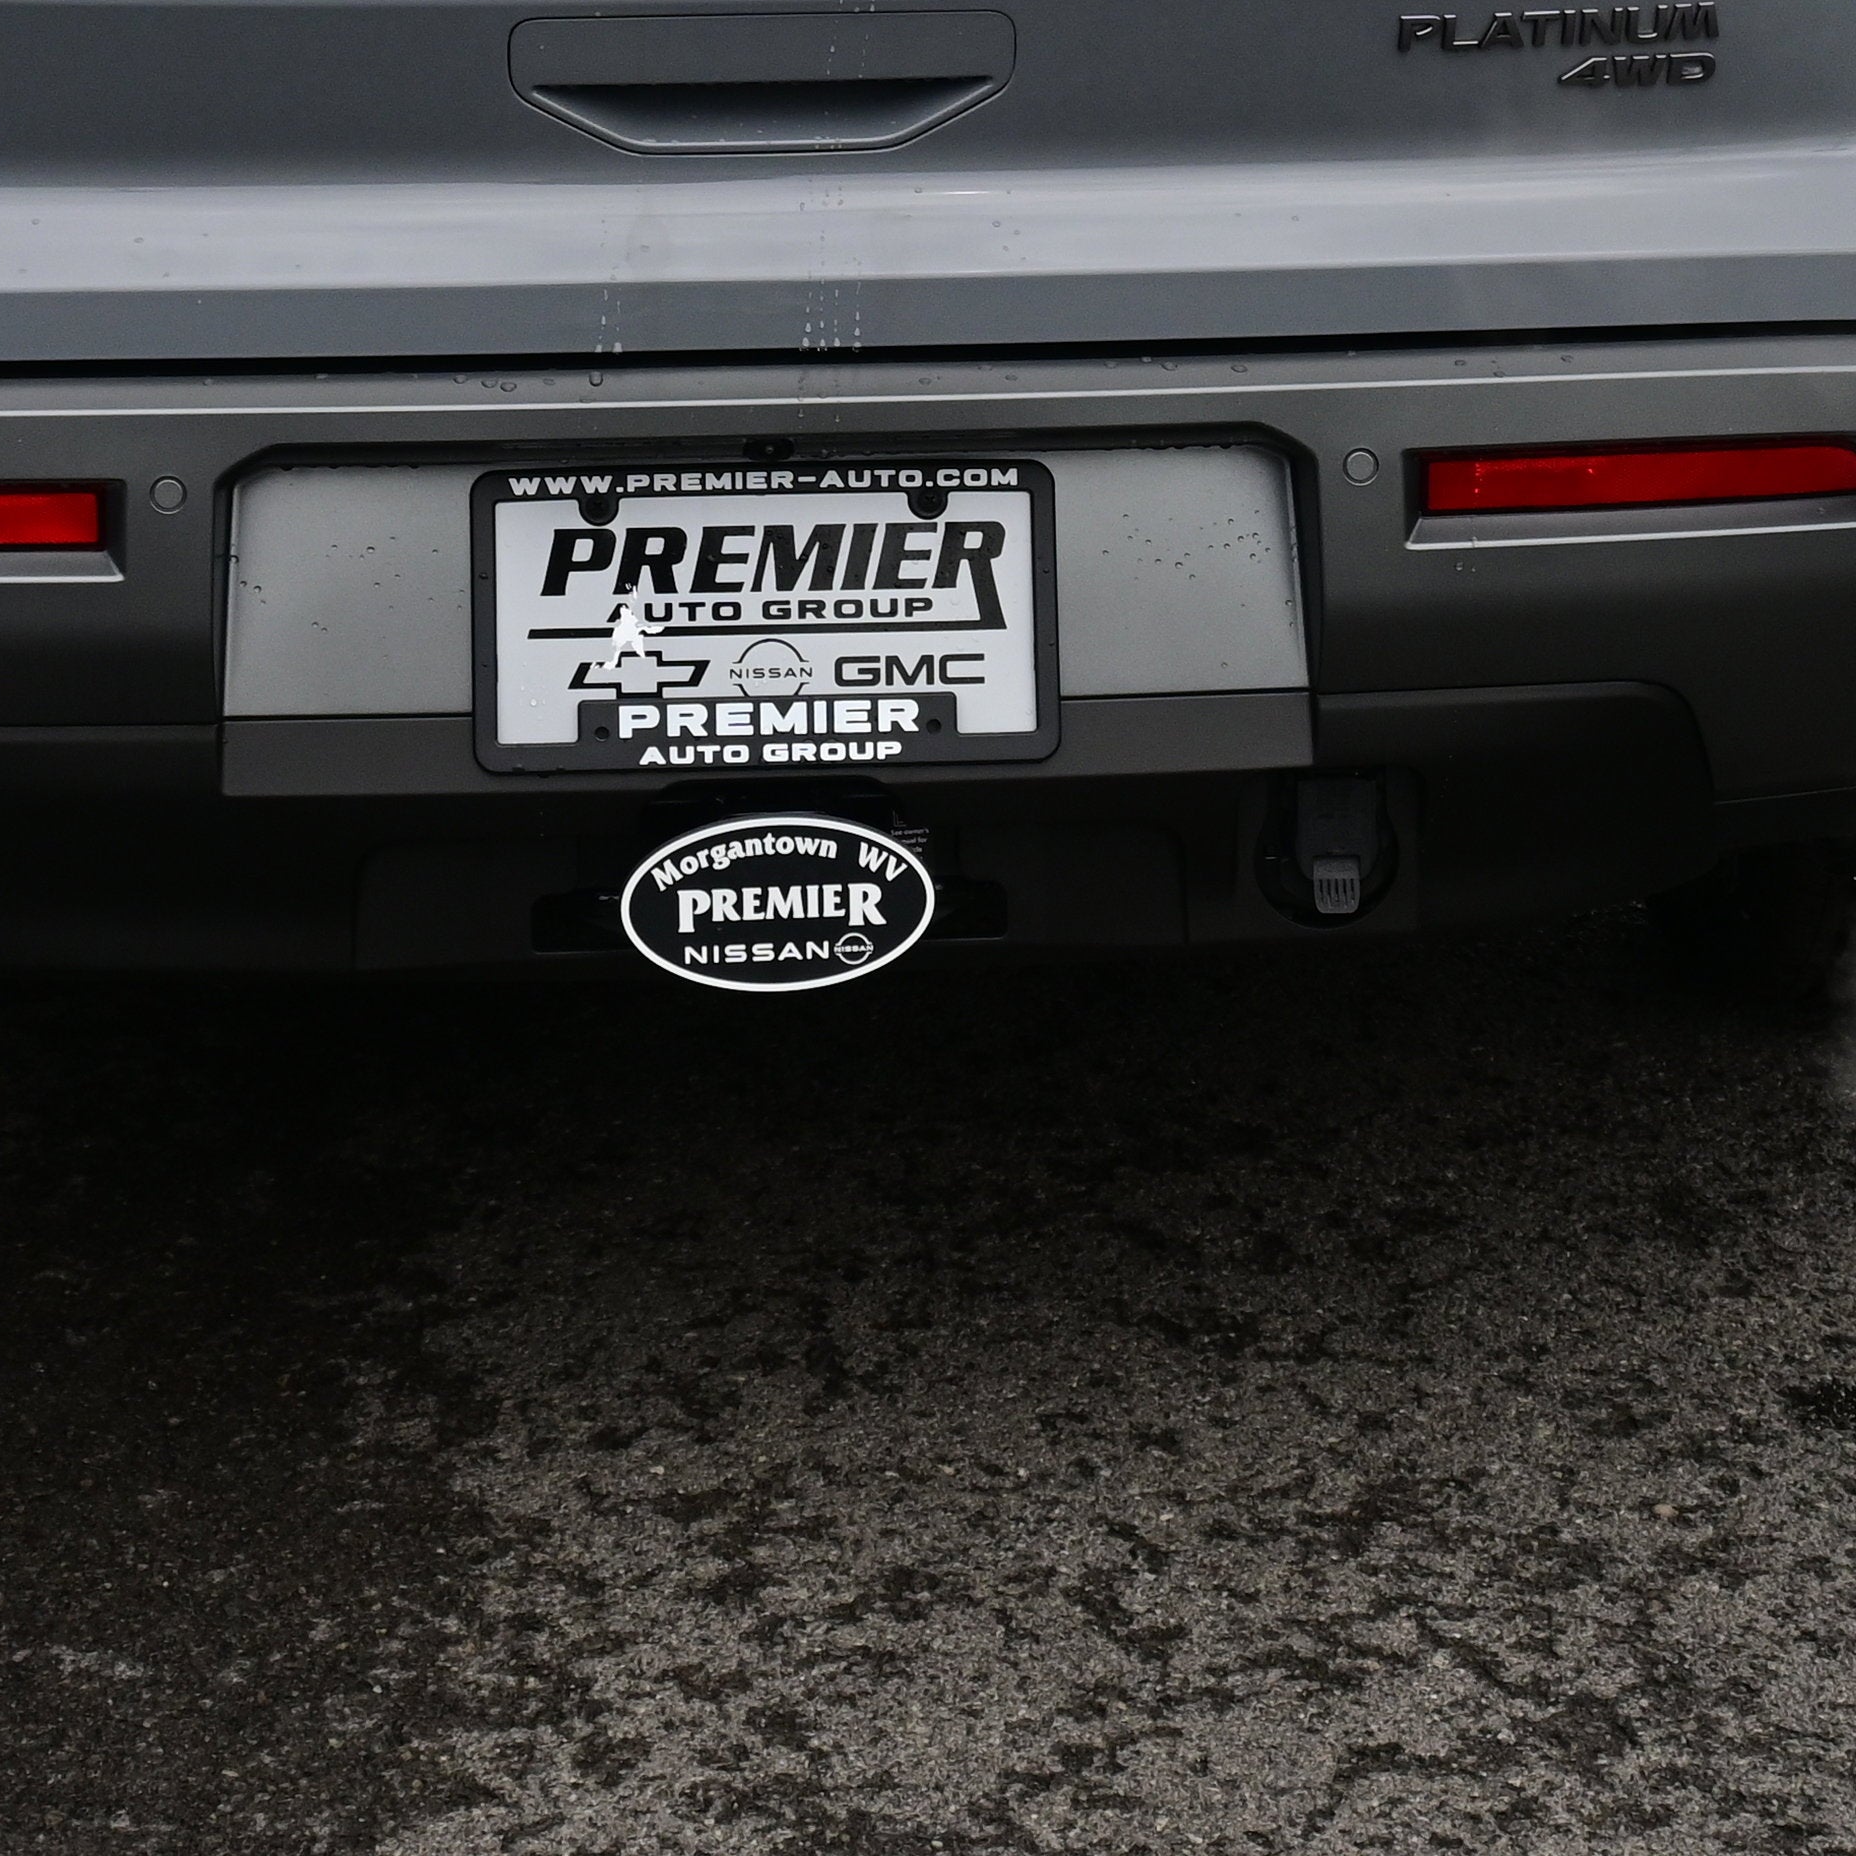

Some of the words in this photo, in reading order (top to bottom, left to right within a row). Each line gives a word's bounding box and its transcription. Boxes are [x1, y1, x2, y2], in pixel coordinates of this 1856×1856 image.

[1397, 1, 1720, 54] PLATINUM
[1557, 52, 1717, 87] 4WD
[508, 467, 1020, 497] WWW.PREMIER-AUTO.COM
[539, 519, 1007, 622] PREMIER
[606, 600, 744, 624] AUTO
[760, 597, 935, 622] GROUP
[729, 666, 814, 681] NISSAN
[833, 652, 986, 688] GMC
[617, 697, 921, 741] PREMIER
[639, 744, 751, 767] AUTO
[761, 740, 903, 764] GROUP
[650, 831, 839, 893] Morgantown
[857, 841, 909, 883] WV
[676, 882, 888, 934] PREMIER
[684, 940, 830, 965] NISSAN
[834, 944, 874, 953] NISSAN
